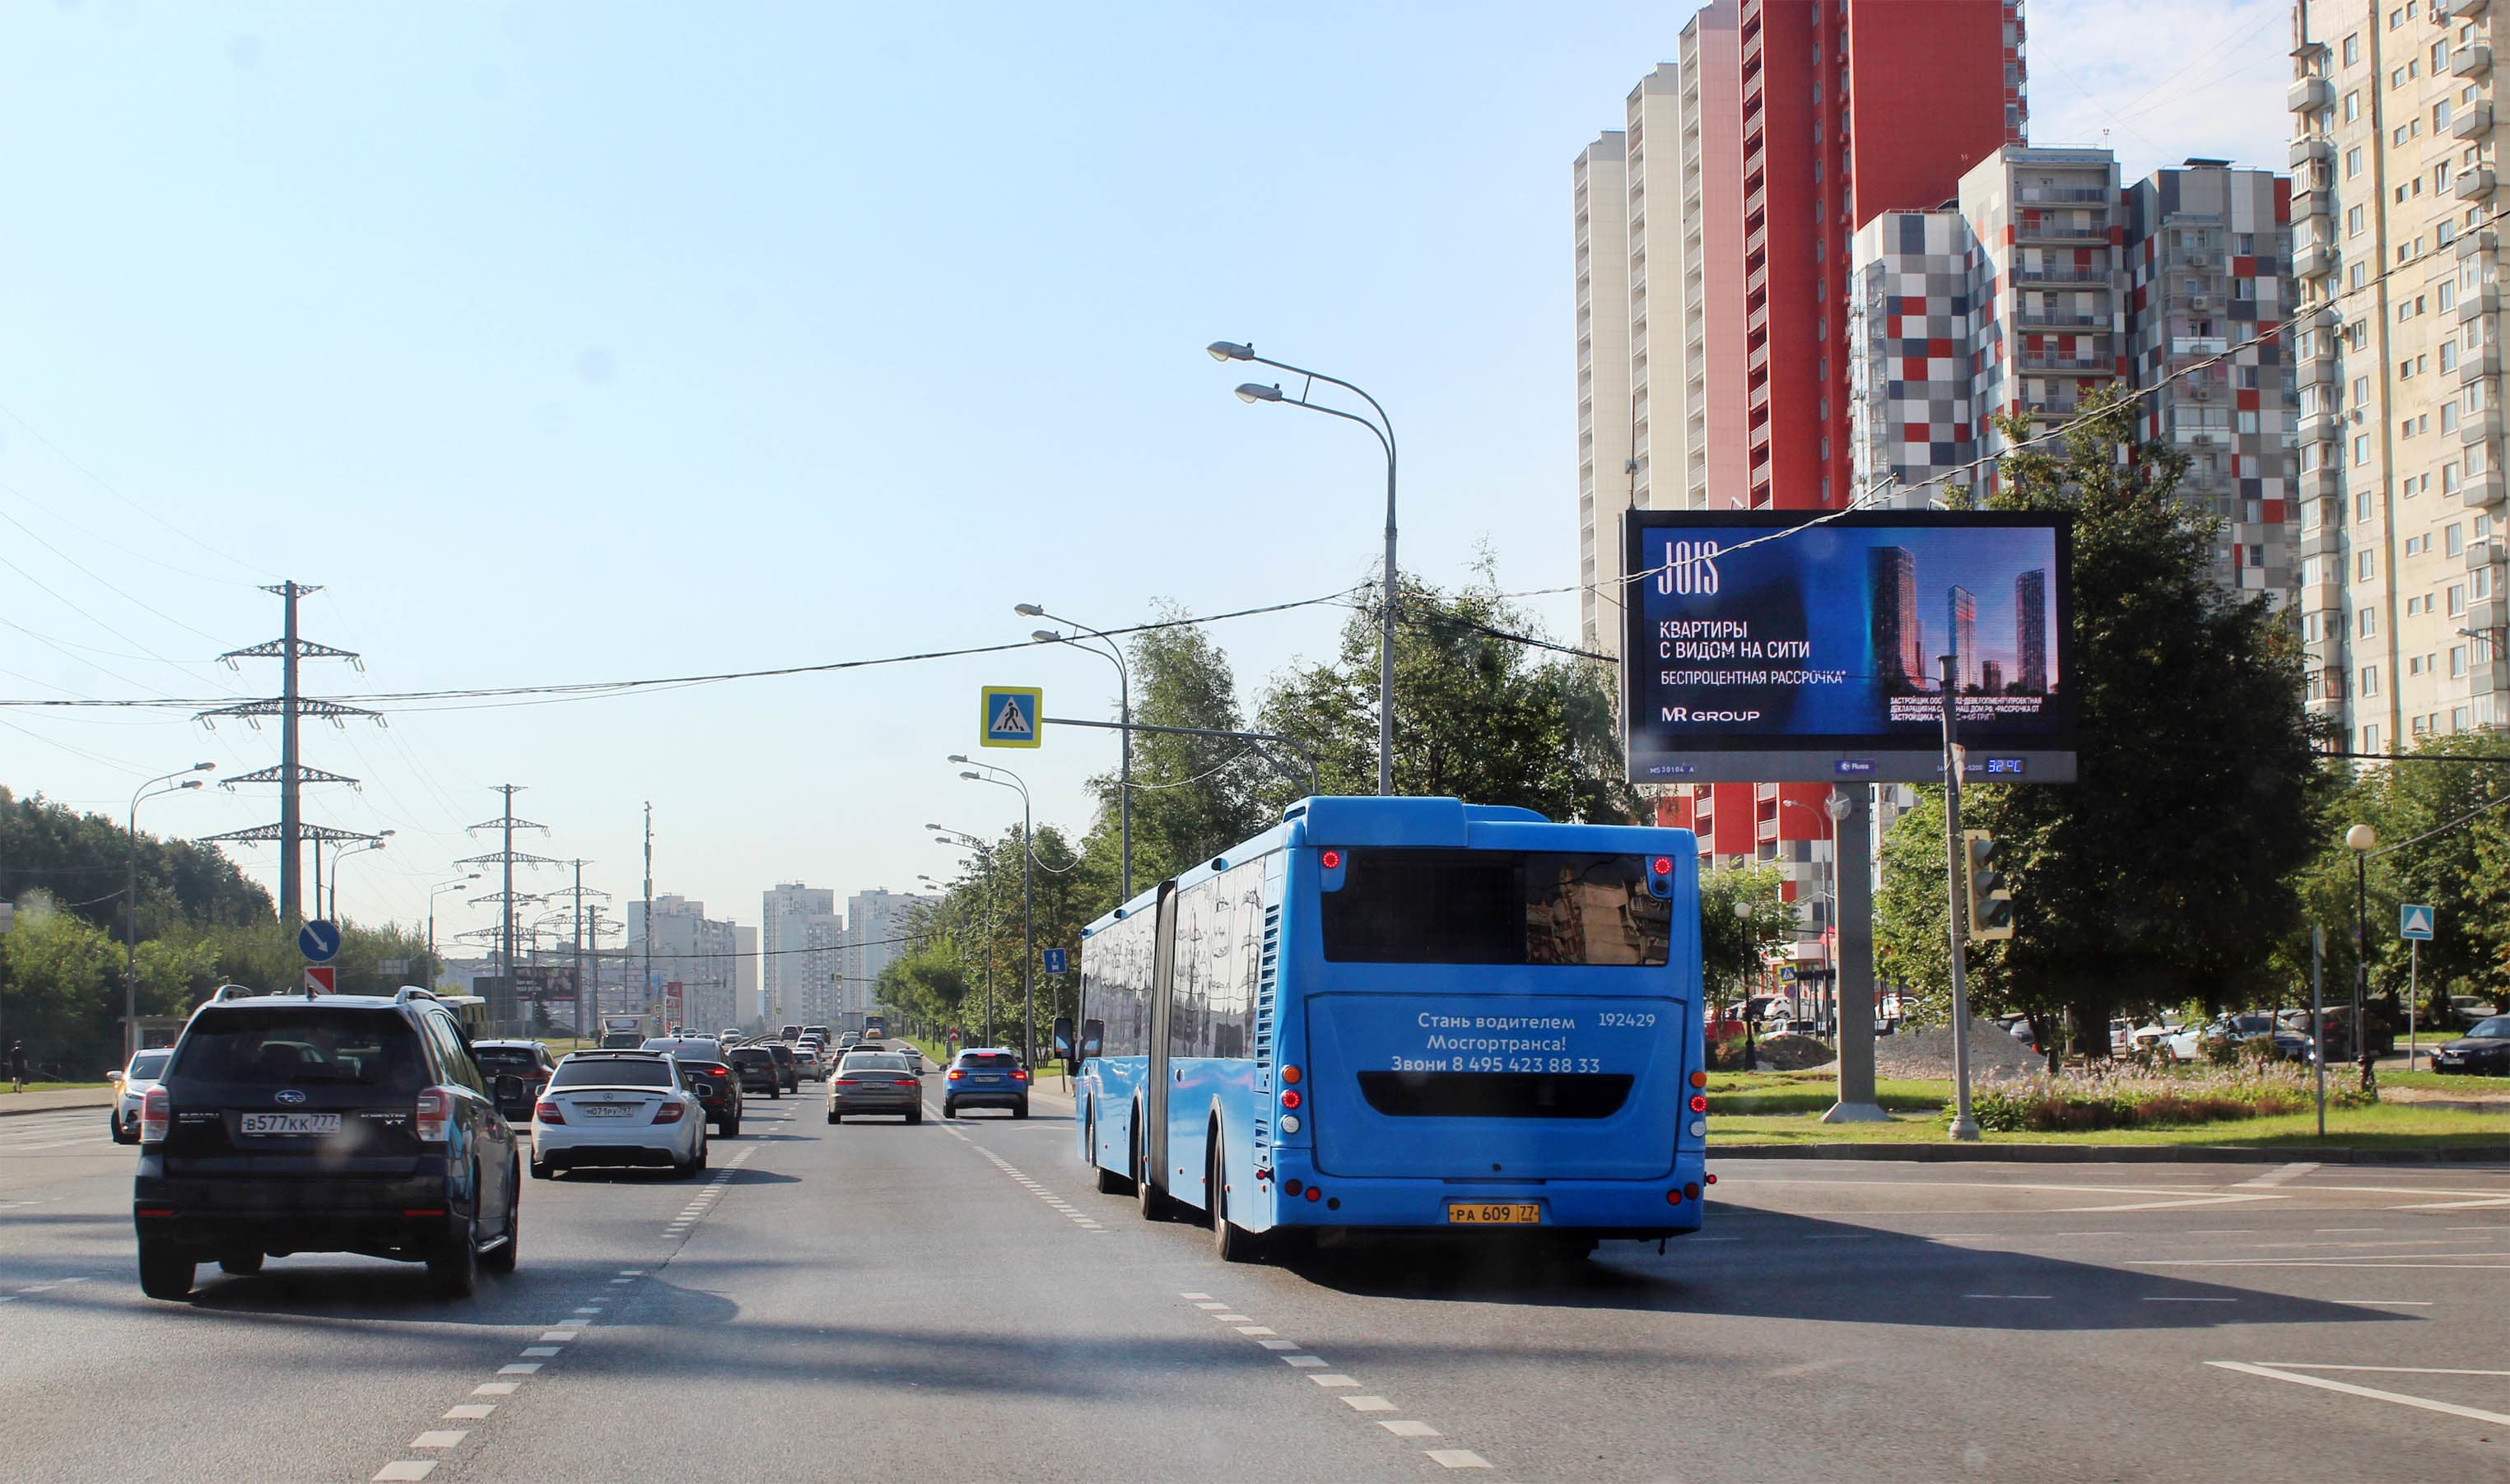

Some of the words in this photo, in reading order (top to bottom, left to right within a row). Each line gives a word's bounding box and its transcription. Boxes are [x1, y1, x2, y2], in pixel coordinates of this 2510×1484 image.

[1658, 541, 1718, 595] JOIS
[1660, 621, 1748, 639] КВАРТИРЫ
[1660, 641, 1670, 658] С
[1676, 641, 1735, 660] ВИДОМ
[1741, 641, 1763, 658] НА
[1767, 641, 1810, 658] СИТИ
[1661, 671, 1767, 686] БЕСПРОЦЕНТНАЯ
[1661, 707, 1687, 722] MR
[1692, 711, 1760, 721] GROUP
[1418, 1012, 1470, 1028] Стань
[1476, 1015, 1576, 1030] водителем
[1599, 1013, 1656, 1027] 192429
[1427, 1035, 1567, 1054] Мосгортранса!
[1391, 1056, 1446, 1071] Звони
[1452, 1057, 1463, 1072] 8
[1469, 1057, 1502, 1072] 495
[1509, 1058, 1543, 1072] 423
[1548, 1058, 1572, 1072] 88
[1578, 1058, 1600, 1073] 33
[247, 1115, 309, 1132] В577КК
[310, 1114, 337, 1127] 777
[1455, 1209, 1475, 1221] РА
[1482, 1206, 1511, 1221] 609
[1519, 1205, 1534, 1217] 77
